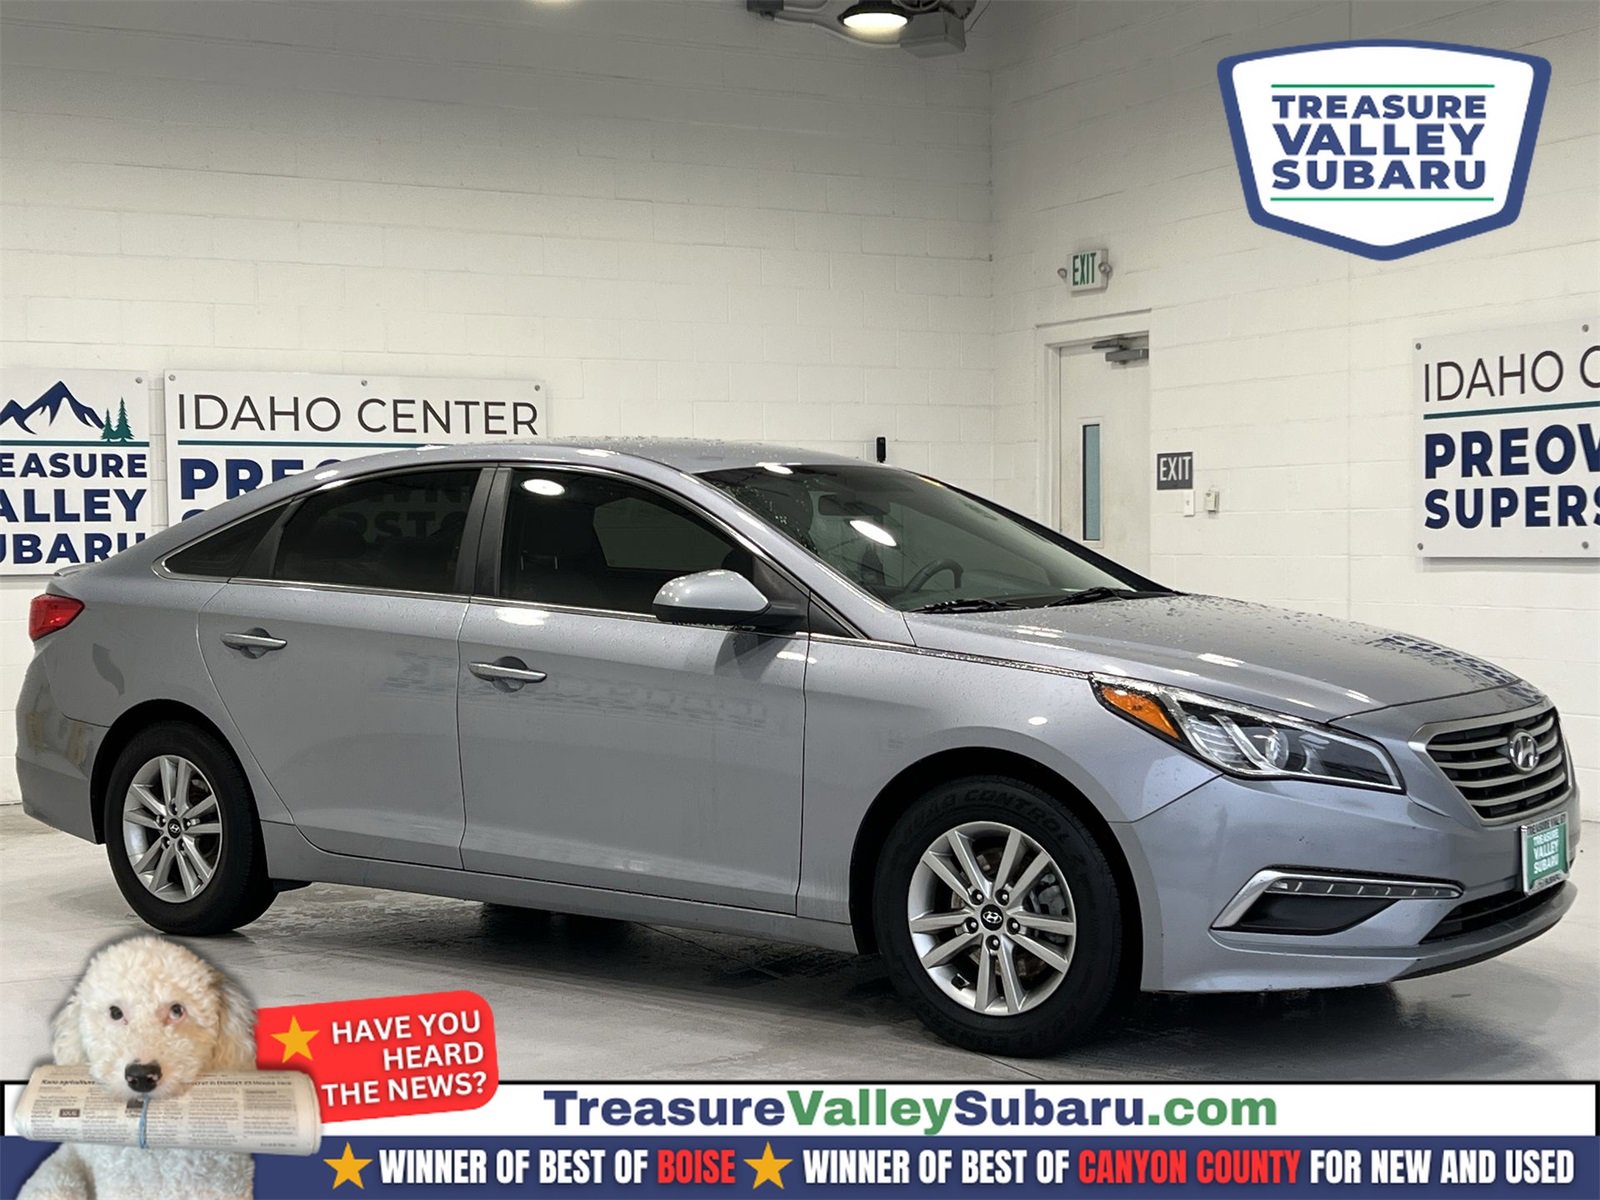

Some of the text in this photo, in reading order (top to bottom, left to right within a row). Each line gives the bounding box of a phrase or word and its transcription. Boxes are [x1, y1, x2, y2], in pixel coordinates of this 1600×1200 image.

[1072, 252, 1097, 286] EXIT
[1424, 350, 1564, 403] IDAHO
[178, 393, 538, 435] IDAHO CENTER
[1160, 456, 1192, 482] EXIT
[1533, 828, 1560, 847] TREASURE
[1533, 839, 1560, 861] VALLEY
[1533, 853, 1560, 875] SUBARU
